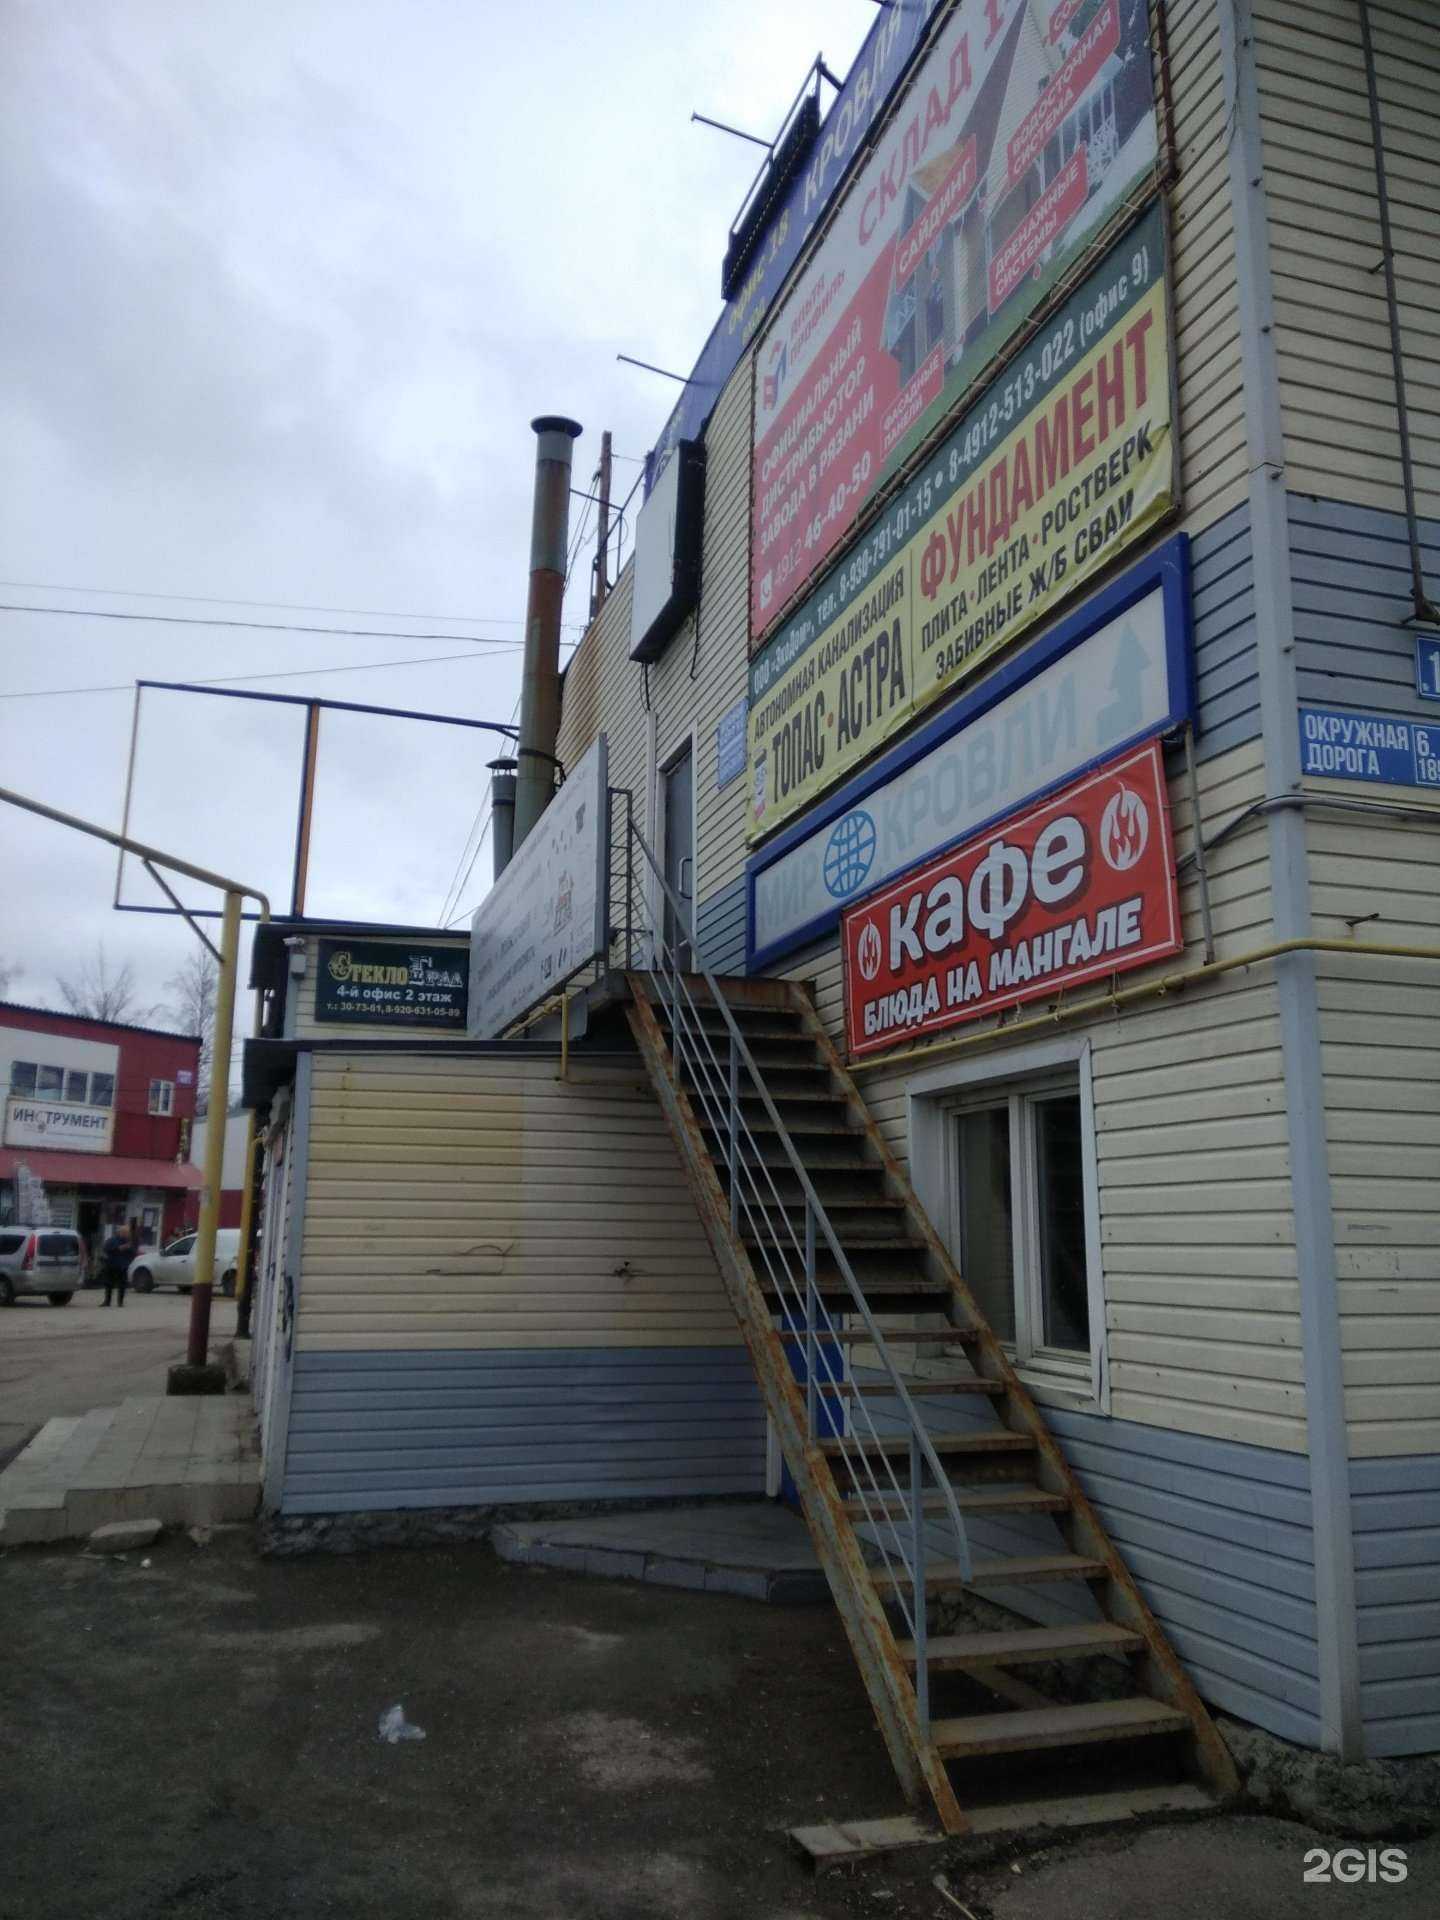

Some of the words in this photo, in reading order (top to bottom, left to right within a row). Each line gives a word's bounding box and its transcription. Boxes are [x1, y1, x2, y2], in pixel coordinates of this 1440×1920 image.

[858, 32, 973, 247] СКЛАД
[1013, 8, 1111, 154] ВОДОСТОЧНАЯ
[1013, 86, 1075, 175] СИСТЕМА
[901, 159, 970, 273] САЙДИНГ
[995, 161, 1079, 278] ДРЕНАЖНЫЕ
[996, 212, 1057, 296] СИСТЕМЫ
[760, 356, 865, 525] ДИСТРИБЬЮТОР
[760, 488, 806, 555] ЗАВОДА
[808, 464, 817, 493] В
[819, 383, 875, 478] РЯЗАНИ
[761, 316, 863, 482] ОФИЦИАЛЬНЫЙ
[817, 593, 838, 625] тел.
[839, 478, 932, 601] 8-930-791-01-15
[950, 318, 1074, 483] 8-4912-513-022
[1080, 275, 1128, 347] (офис
[1132, 245, 1149, 293] 9)
[919, 308, 1153, 602] ФУНДАМЕНТ
[803, 450, 872, 550] 46-40-50
[921, 591, 968, 653] ПЛИТА
[976, 534, 1029, 606] ЛЕНТА
[1041, 419, 1153, 547] РОСТВЕРК
[754, 652, 815, 742] АВТОНОМНАЯ
[817, 566, 904, 680] КАНАЛИЗАЦИЯ
[935, 585, 1023, 680] ЗАБИВНЫЕ
[1028, 545, 1067, 600] Ж/Б
[1074, 487, 1134, 565] СВАИ
[772, 690, 825, 804] ТОПАС
[837, 615, 906, 752] АСТРА
[882, 671, 1078, 860] КРОВЛИ
[1304, 714, 1409, 751] ОКРУЖНАЯ
[1307, 743, 1380, 775] ДОРОГА
[1418, 757, 1440, 780] 18
[336, 984, 359, 997] 4-й
[363, 987, 401, 1001] офис
[405, 989, 414, 1001] 2
[418, 991, 453, 1002] этаж
[864, 977, 941, 1036] БЛЮДА
[947, 961, 982, 1006] НА
[989, 898, 1142, 991] МАНГАЛЕ
[13, 1107, 108, 1131] ИНСТРУМЕНТ
